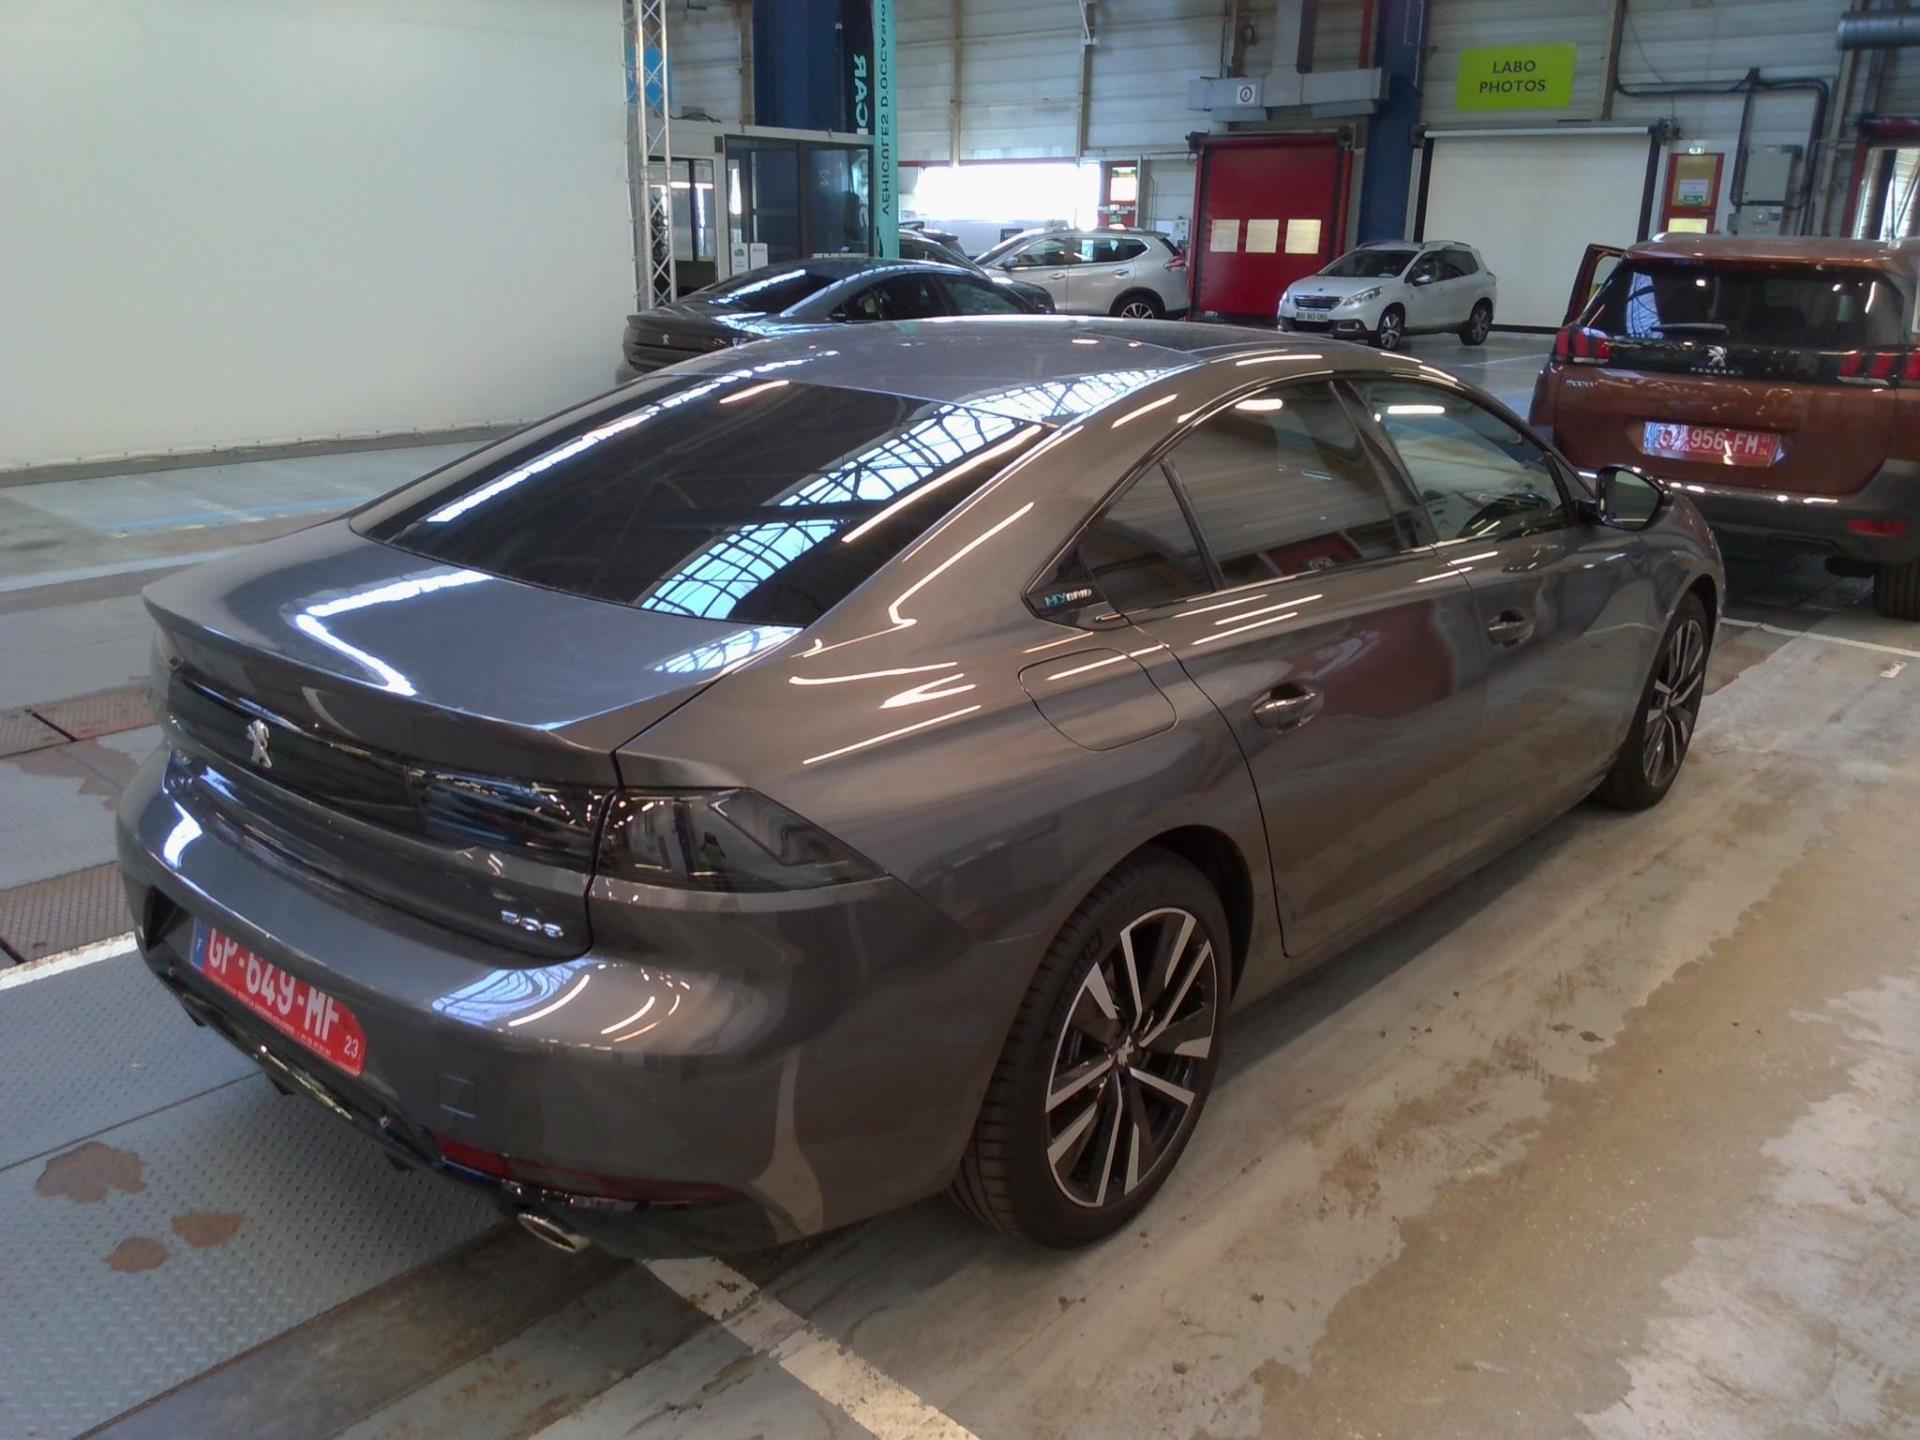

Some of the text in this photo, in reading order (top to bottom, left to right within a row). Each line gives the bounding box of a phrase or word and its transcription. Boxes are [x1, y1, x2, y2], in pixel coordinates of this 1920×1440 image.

[1492, 60, 1536, 74] LABO
[1479, 79, 1546, 94] PHOTOS
[343, 1034, 359, 1058] 23
